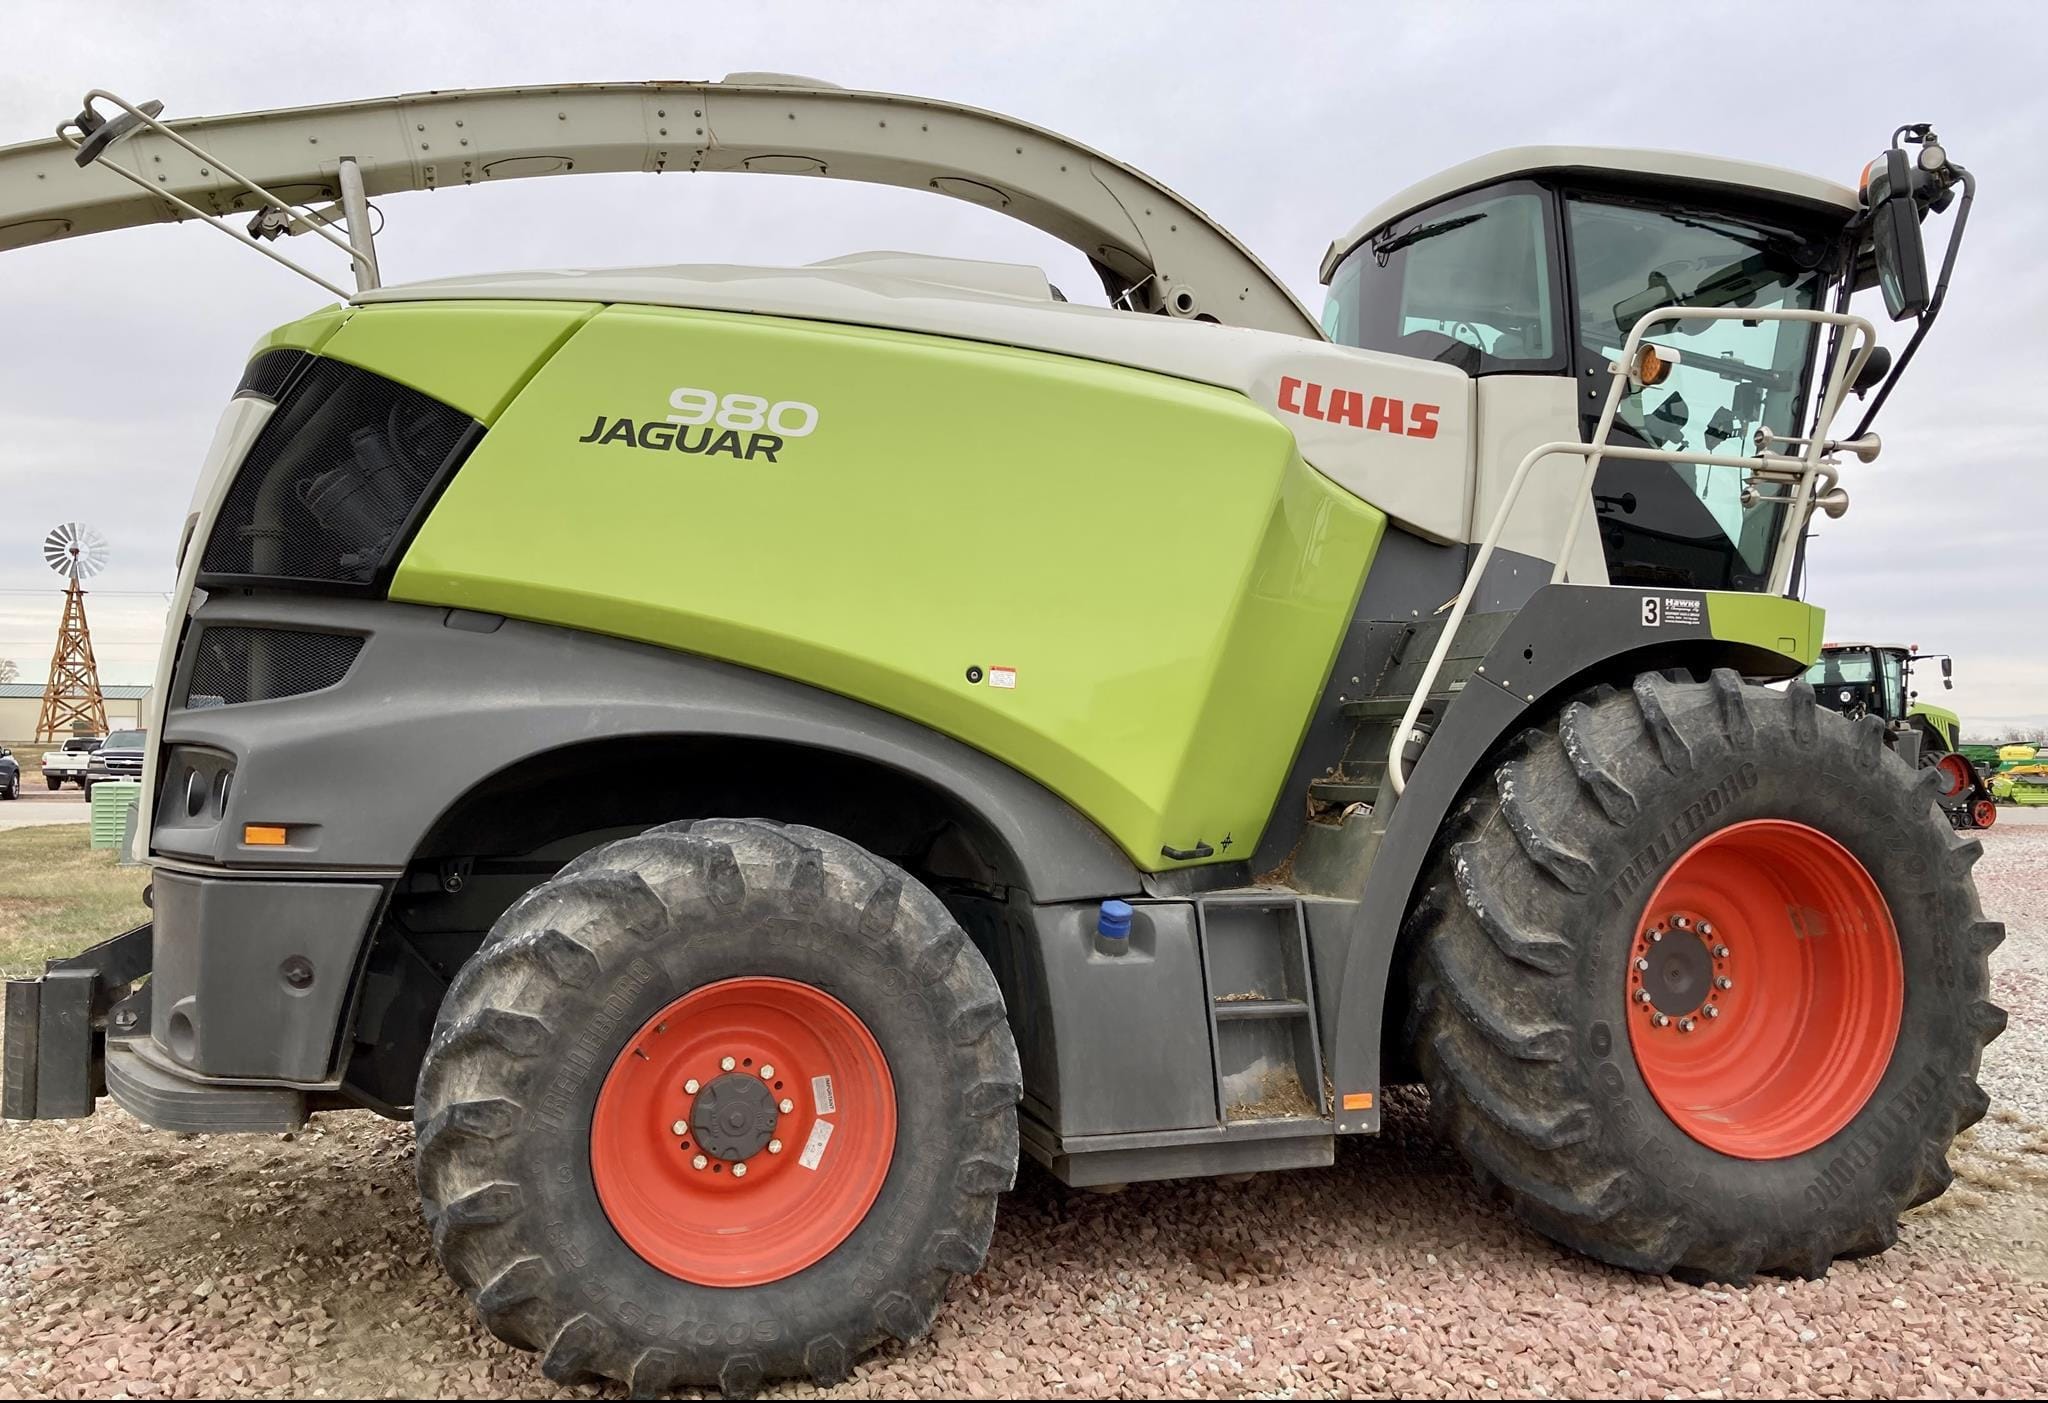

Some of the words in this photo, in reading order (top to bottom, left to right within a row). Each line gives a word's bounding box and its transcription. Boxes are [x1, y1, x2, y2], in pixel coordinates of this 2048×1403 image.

[667, 388, 818, 437] 980
[1278, 376, 1440, 439] CLAAS
[579, 416, 783, 462] JAGUAR
[1645, 599, 1657, 624] 3
[529, 957, 652, 1136] TRELLEBORG
